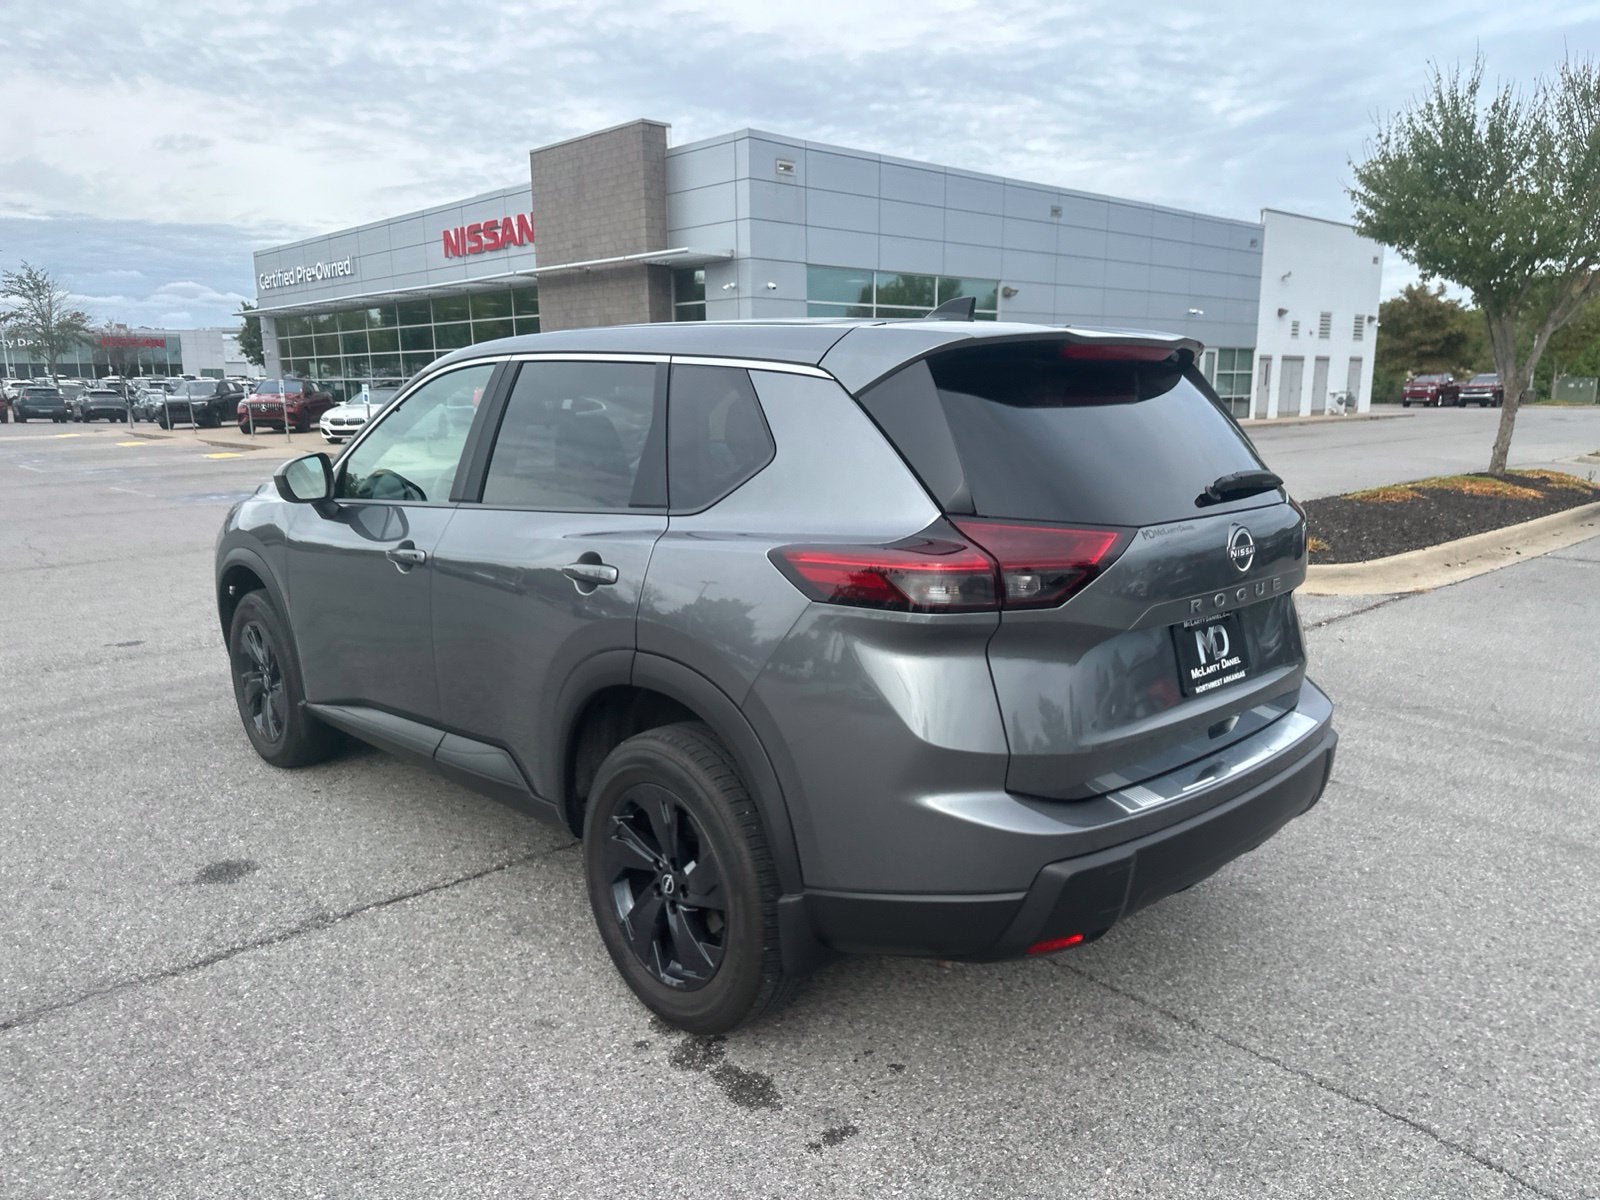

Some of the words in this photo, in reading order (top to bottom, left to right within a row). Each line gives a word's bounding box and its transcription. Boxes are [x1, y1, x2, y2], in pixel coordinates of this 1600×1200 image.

[442, 211, 535, 258] NISSAN
[259, 267, 295, 290] Certified
[296, 256, 351, 284] Pre-Owned
[1190, 577, 1282, 614] ROGUE
[1195, 678, 1223, 694] NORTHWEST
[1223, 670, 1246, 684] ARKANSAS
